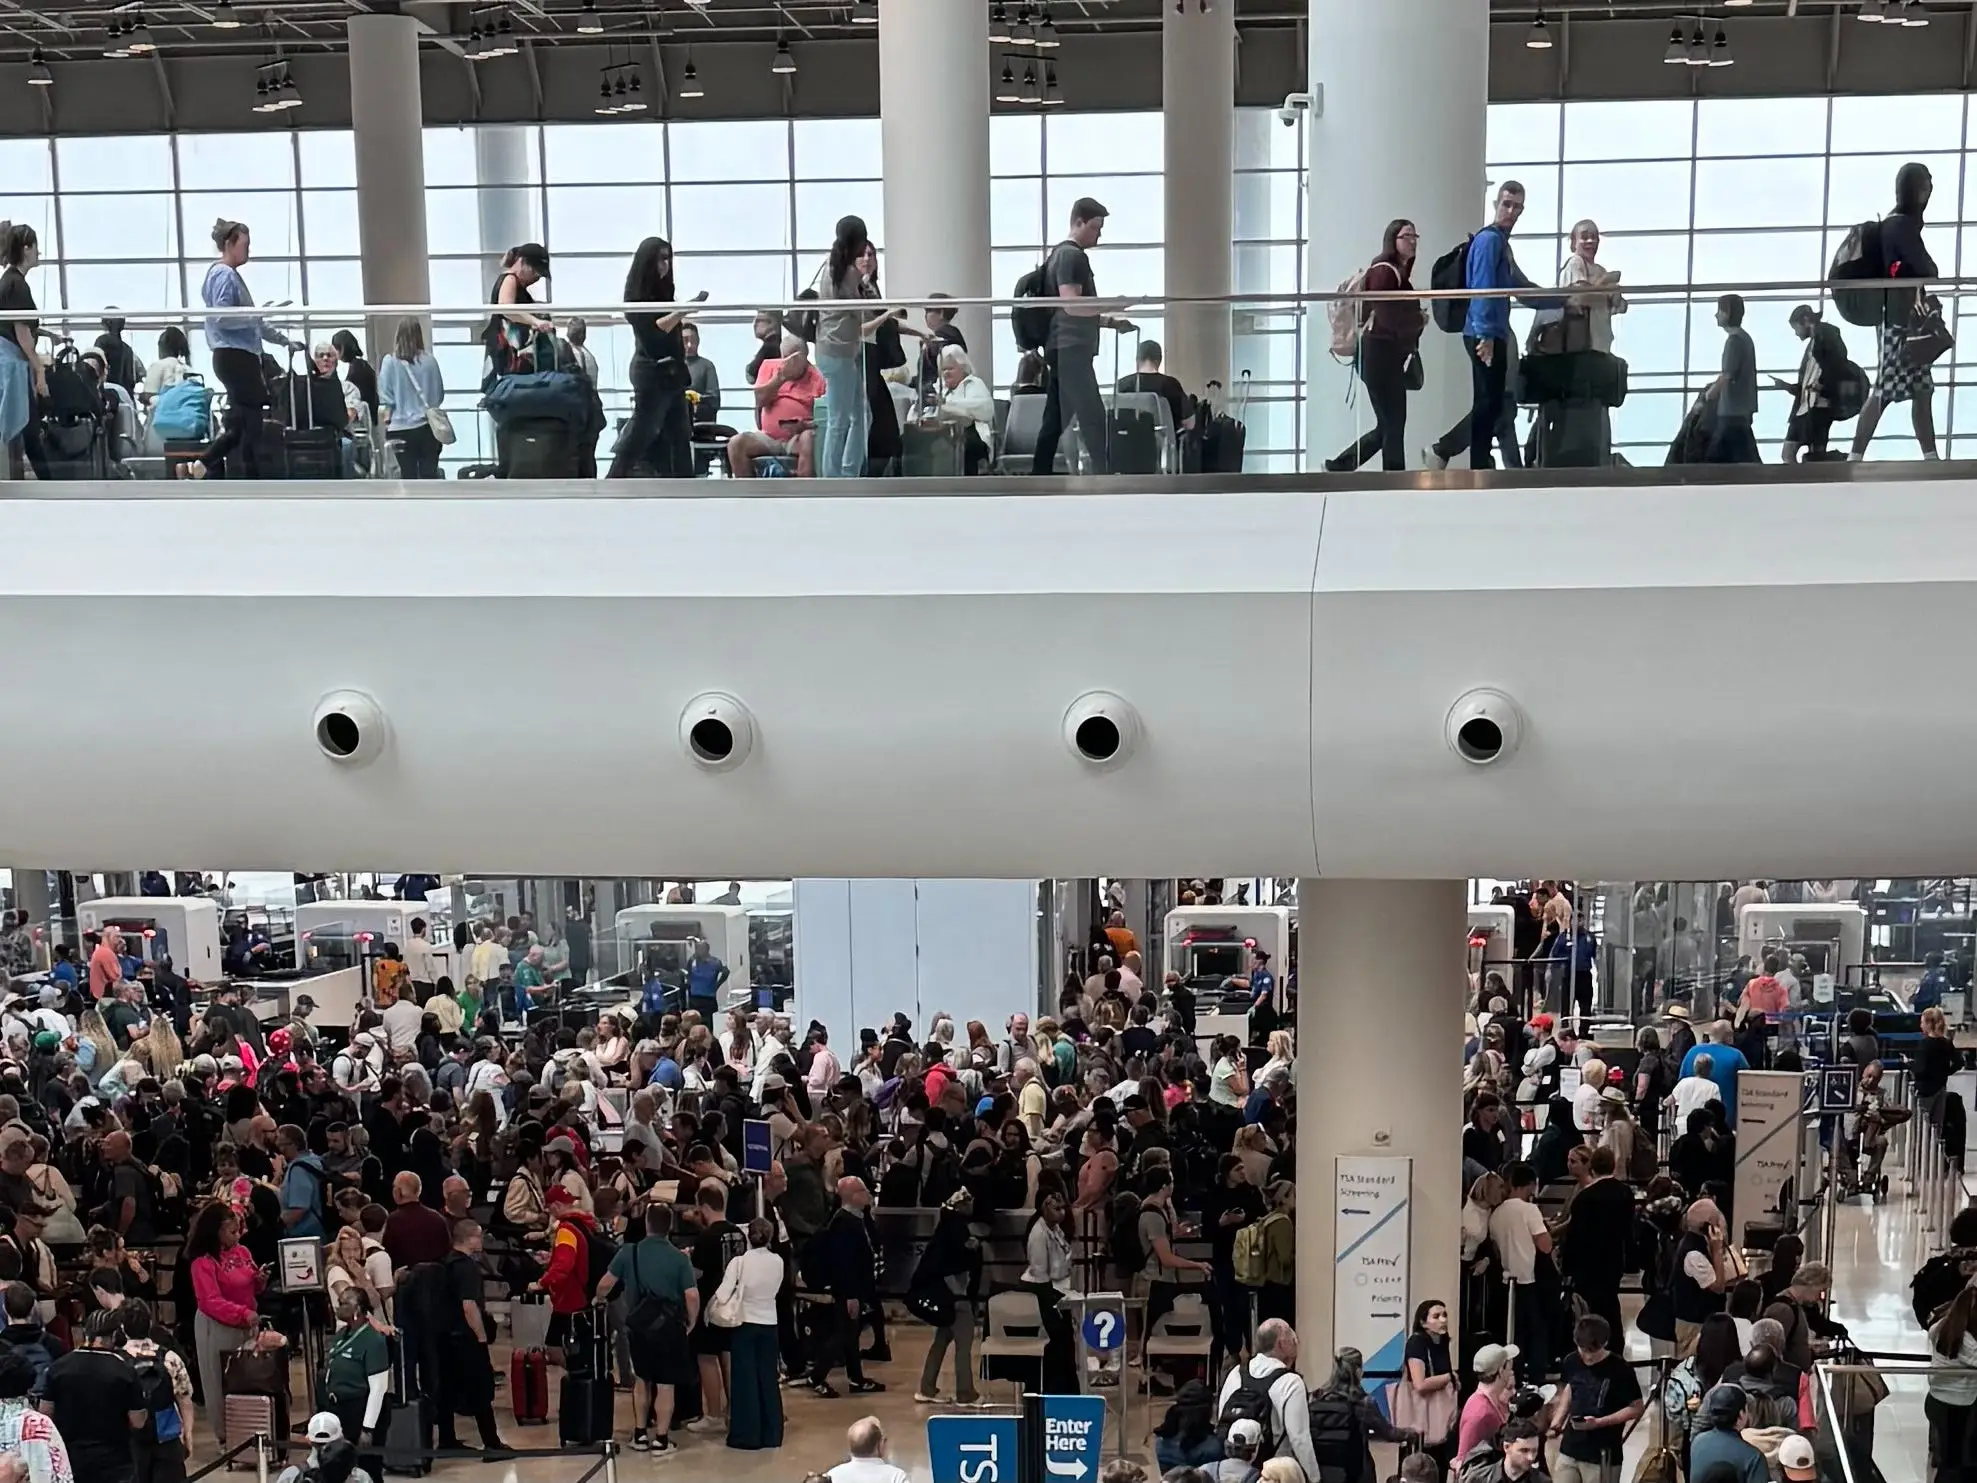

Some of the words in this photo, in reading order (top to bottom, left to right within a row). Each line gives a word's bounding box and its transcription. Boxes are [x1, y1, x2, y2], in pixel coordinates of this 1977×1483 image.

[1045, 1417, 1092, 1434] Enter
[1045, 1434, 1088, 1451] Here
[959, 1433, 999, 1483] TS
